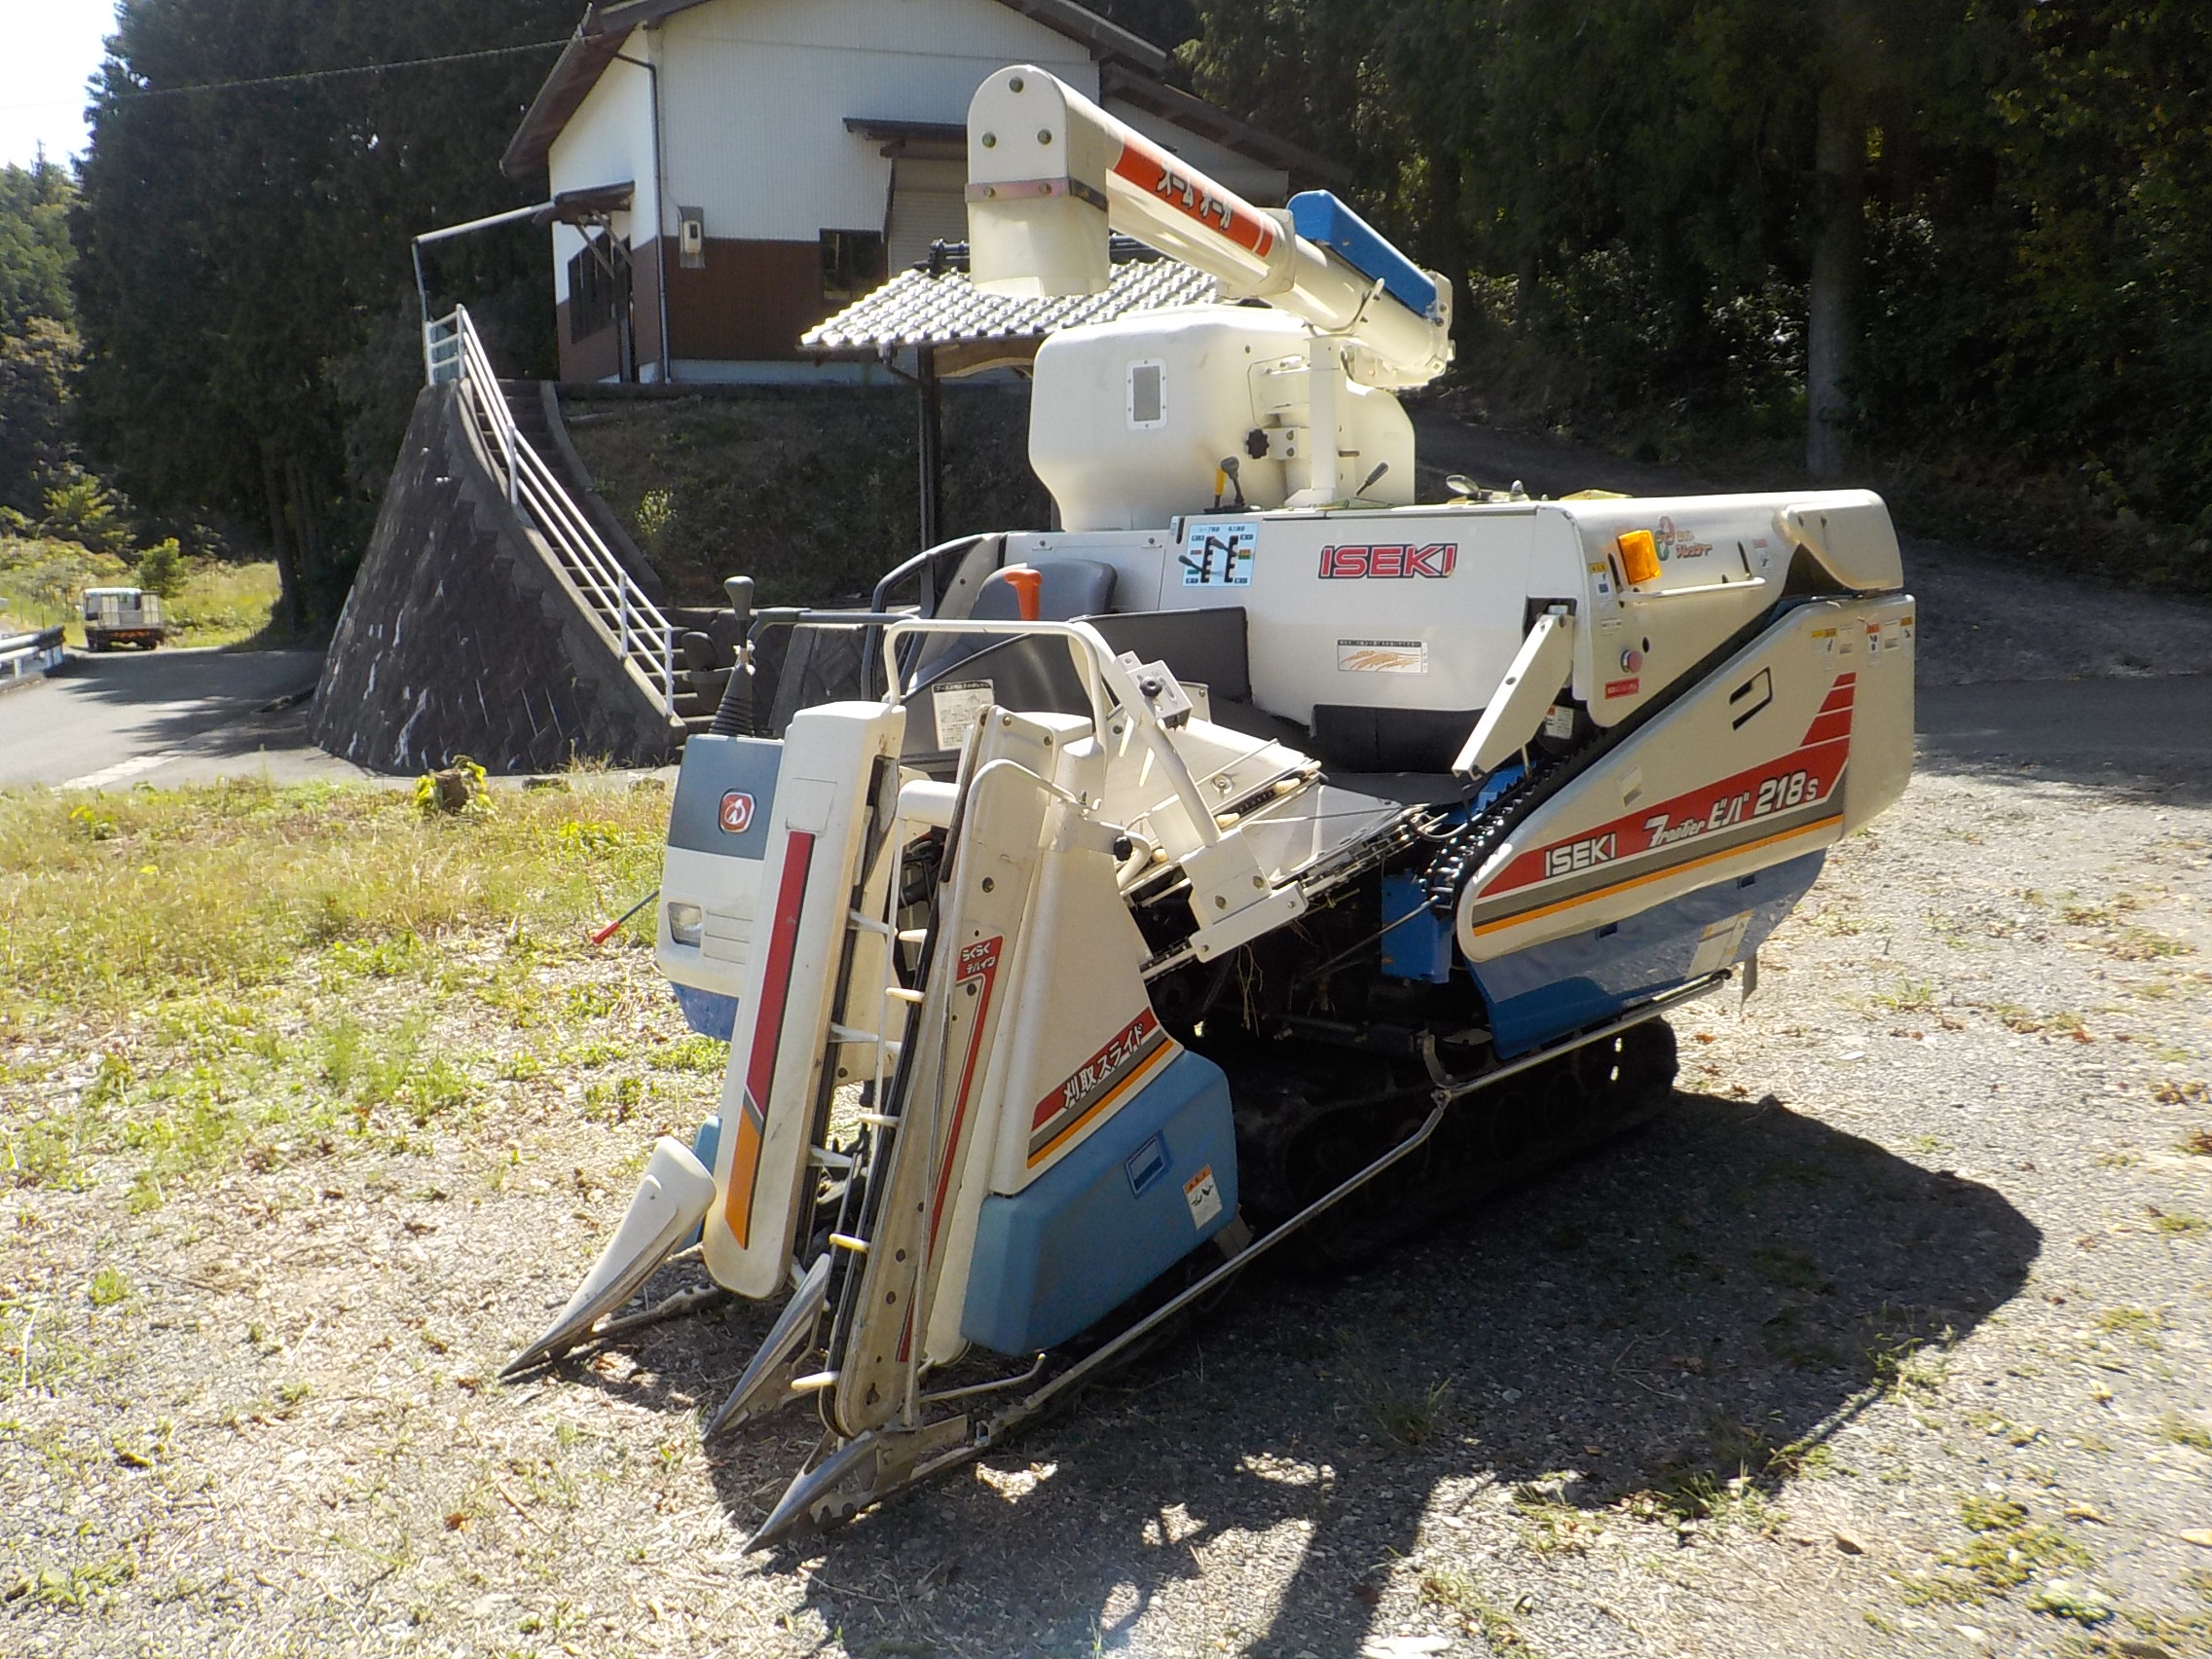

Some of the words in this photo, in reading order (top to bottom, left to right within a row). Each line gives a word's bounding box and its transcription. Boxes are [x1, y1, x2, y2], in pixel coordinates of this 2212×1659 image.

[1318, 543, 1457, 579] ISEKI
[1545, 832, 1617, 878] ISEKI
[962, 941, 991, 963] らくらく
